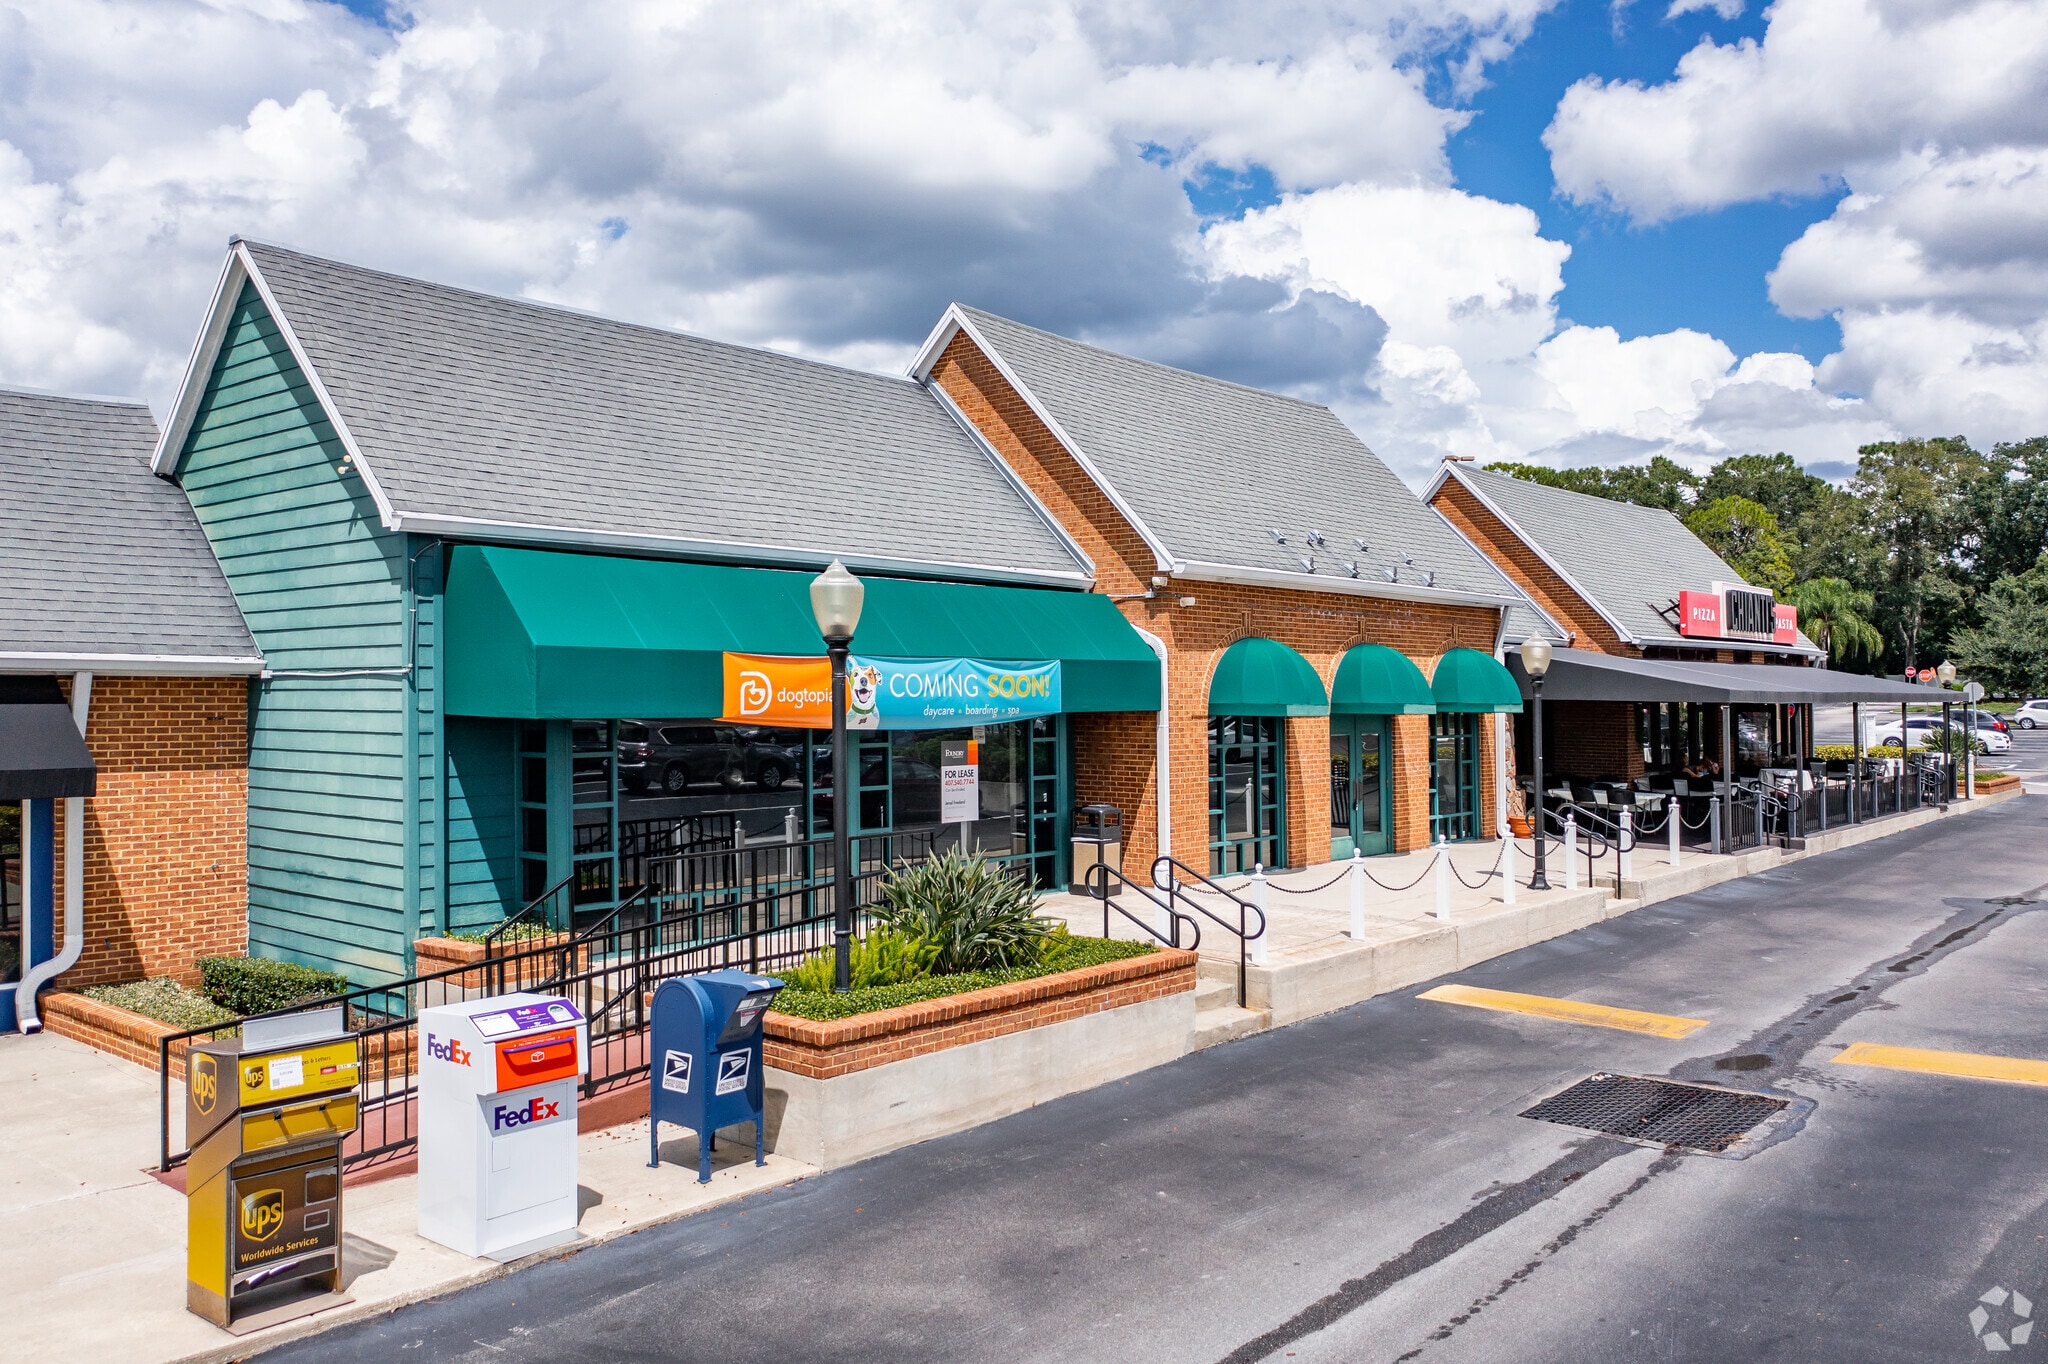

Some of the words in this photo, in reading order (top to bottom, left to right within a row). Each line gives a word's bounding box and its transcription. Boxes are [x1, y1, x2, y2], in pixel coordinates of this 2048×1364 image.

[1693, 607, 1716, 622] PIZZA
[1775, 618, 1794, 630] PASTA
[889, 673, 979, 698] COMING
[987, 674, 1050, 698] SOON!
[777, 687, 833, 709] dogtopia
[923, 704, 955, 717] daycare
[965, 704, 999, 719] boarding
[1007, 706, 1020, 717] spa
[944, 770, 957, 779] FOR
[957, 769, 974, 778] LEASE
[516, 1008, 538, 1017] FedEx
[315, 1055, 332, 1064] Letters
[427, 1033, 472, 1067] FedEx
[193, 1069, 215, 1106] ups
[245, 1070, 264, 1087] ups
[494, 1097, 560, 1131] FedEx
[243, 1202, 282, 1234] ups
[240, 1245, 285, 1263] Worldwide
[286, 1236, 319, 1252] Services
